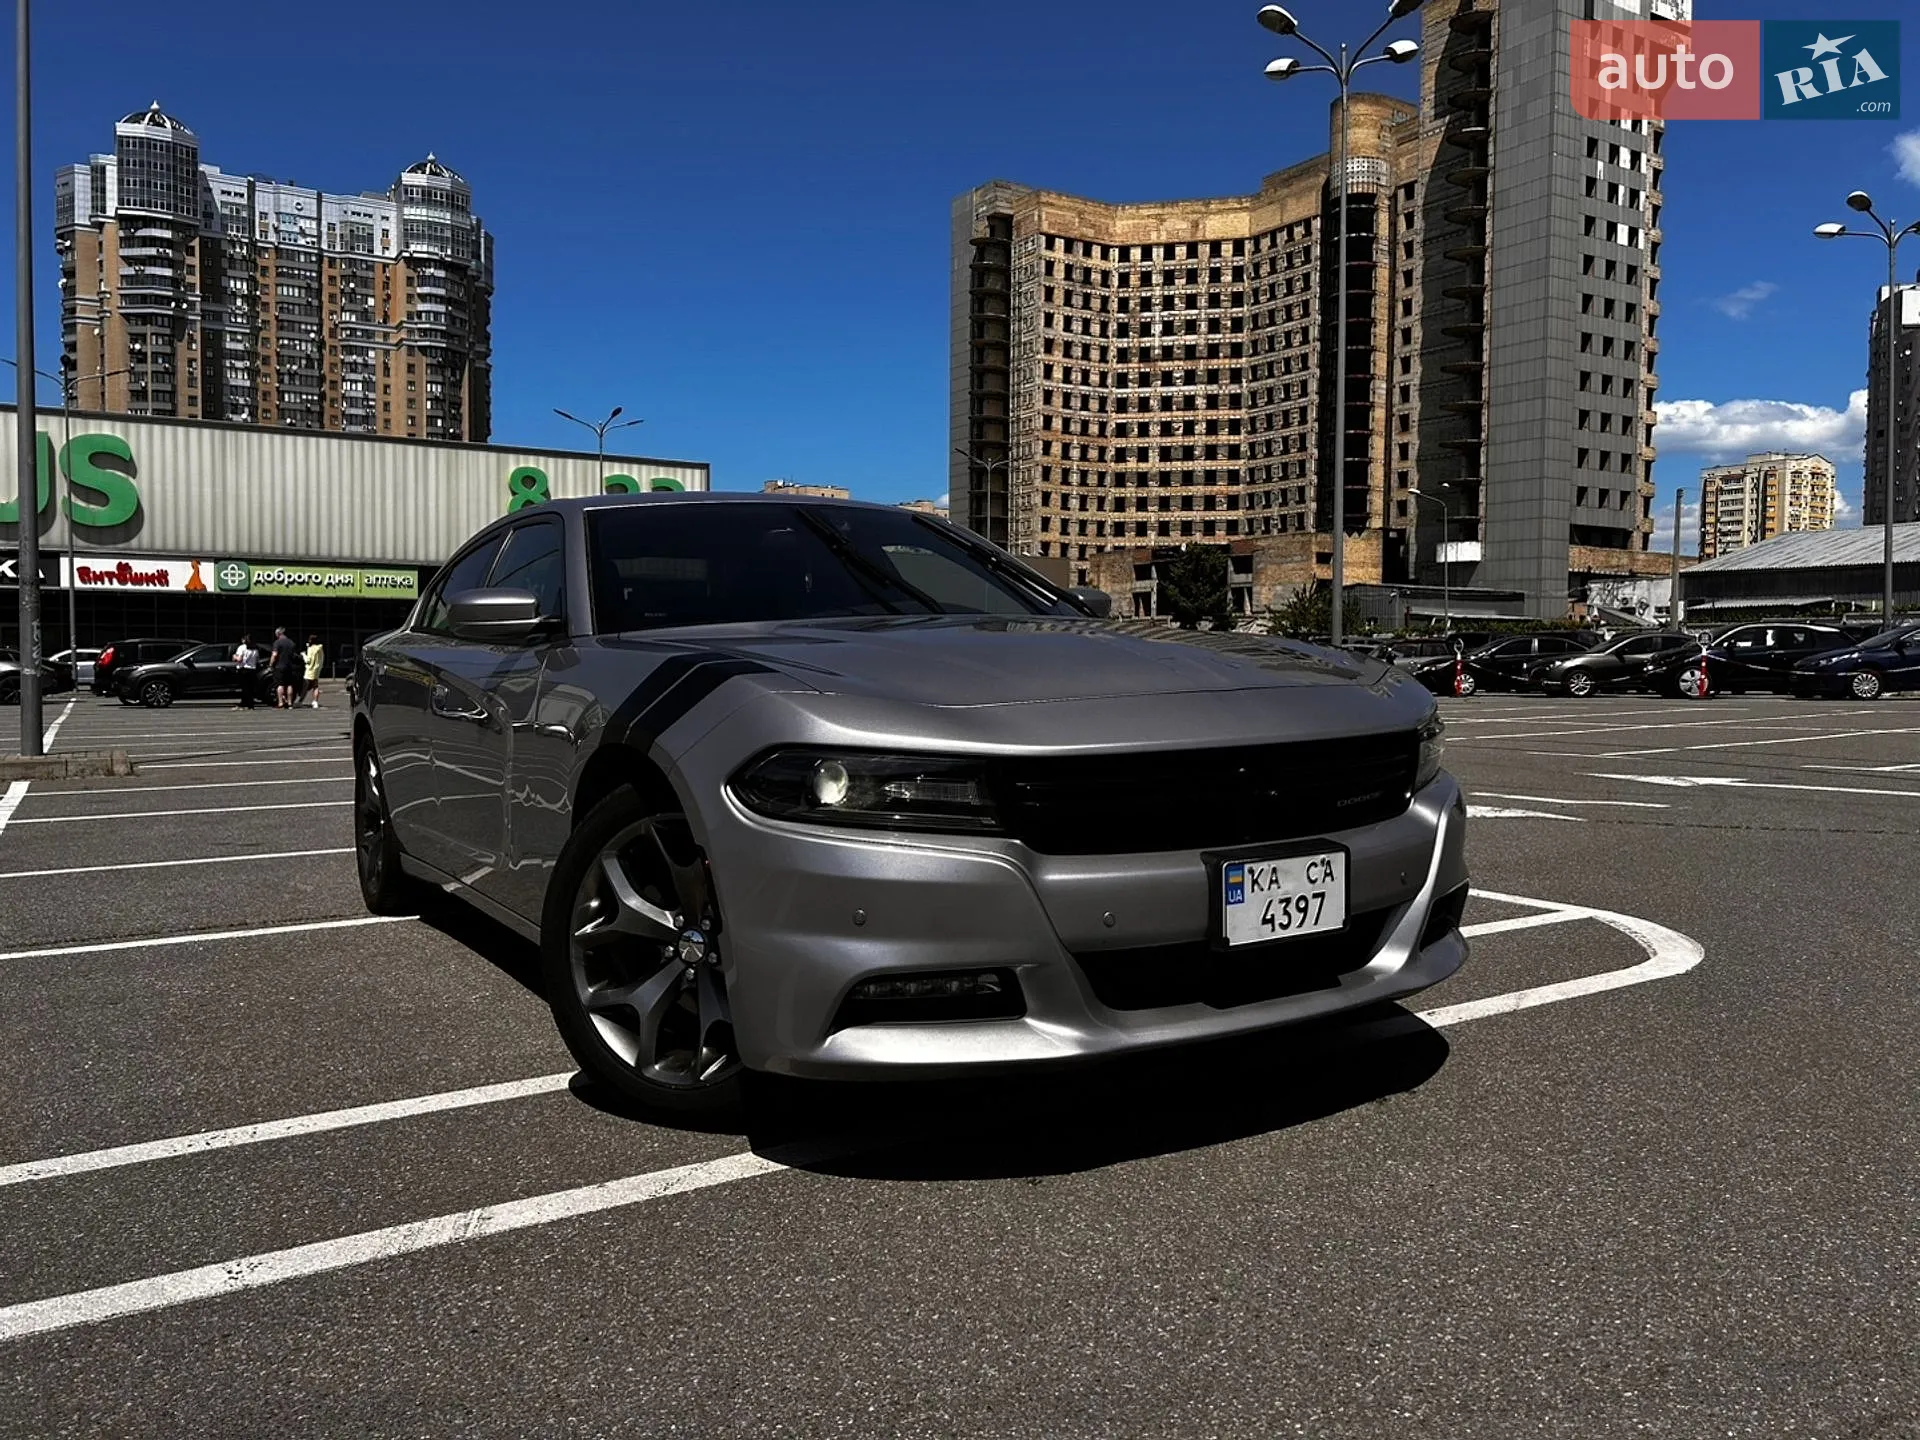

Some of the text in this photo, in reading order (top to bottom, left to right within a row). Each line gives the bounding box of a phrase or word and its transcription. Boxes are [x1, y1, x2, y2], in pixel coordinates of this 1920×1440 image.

[253, 568, 355, 588] доброго дня
[364, 574, 414, 588] аптека
[1249, 859, 1335, 893] KA CA
[1228, 890, 1243, 903] UA
[1261, 892, 1326, 932] 4397
